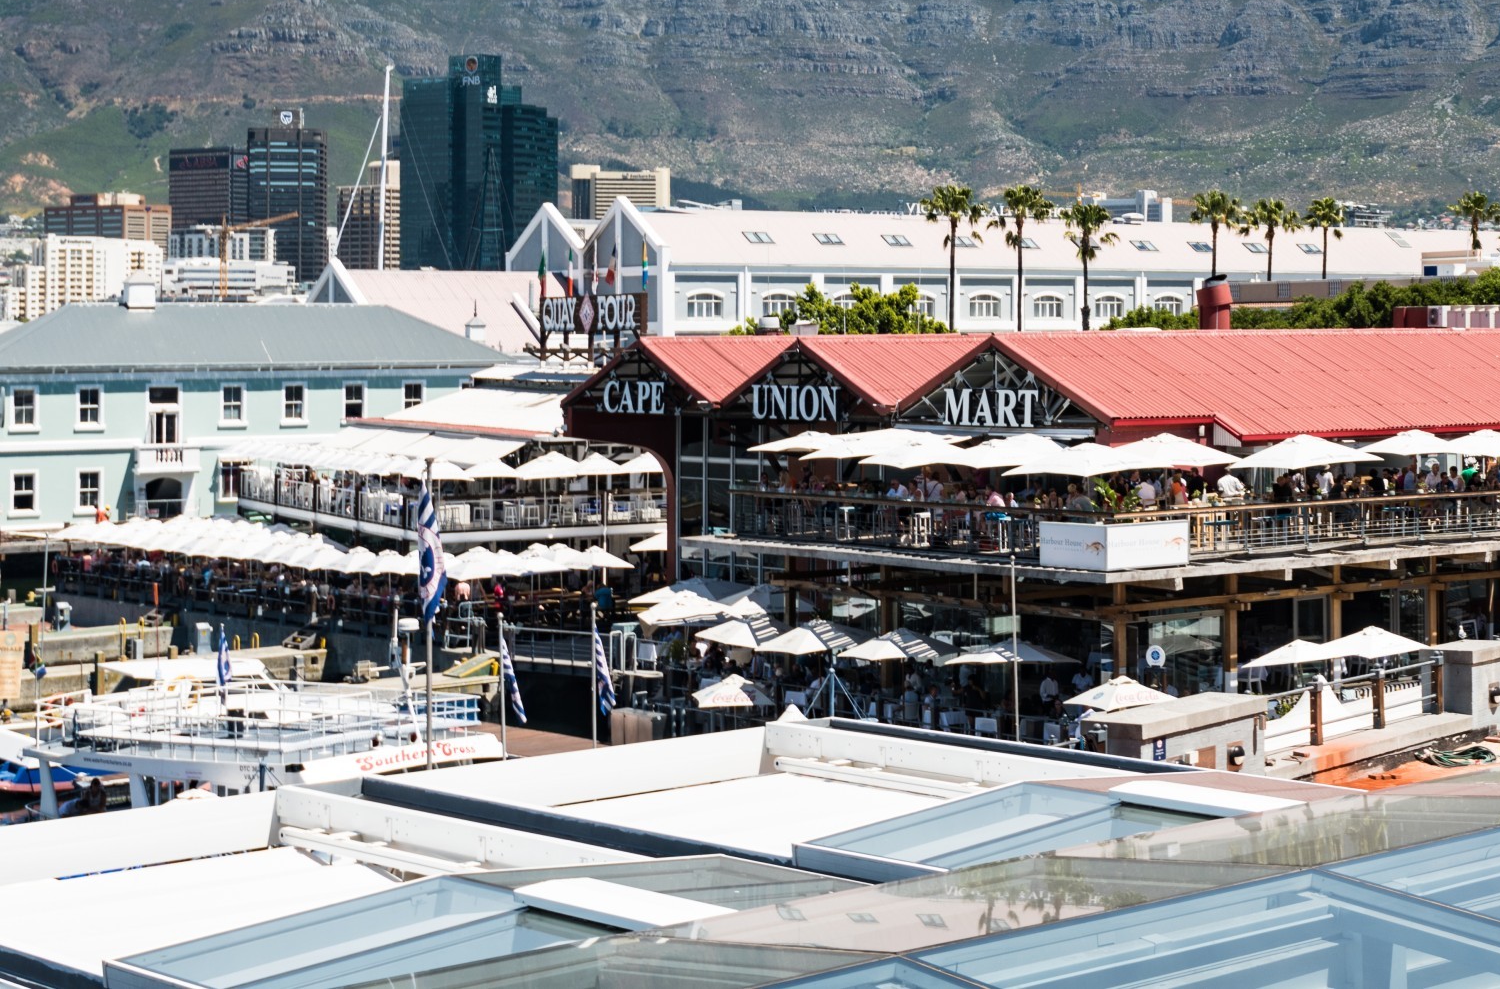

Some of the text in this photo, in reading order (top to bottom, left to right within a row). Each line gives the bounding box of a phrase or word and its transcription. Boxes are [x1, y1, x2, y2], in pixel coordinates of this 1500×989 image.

[462, 76, 480, 86] FNB
[543, 294, 636, 330] QUAY FOUR
[603, 380, 1039, 428] CAPE UNION MART
[1041, 537, 1083, 546] Harbour House
[1115, 691, 1160, 705] Coca-Cola
[355, 742, 476, 772] Southern Cross
